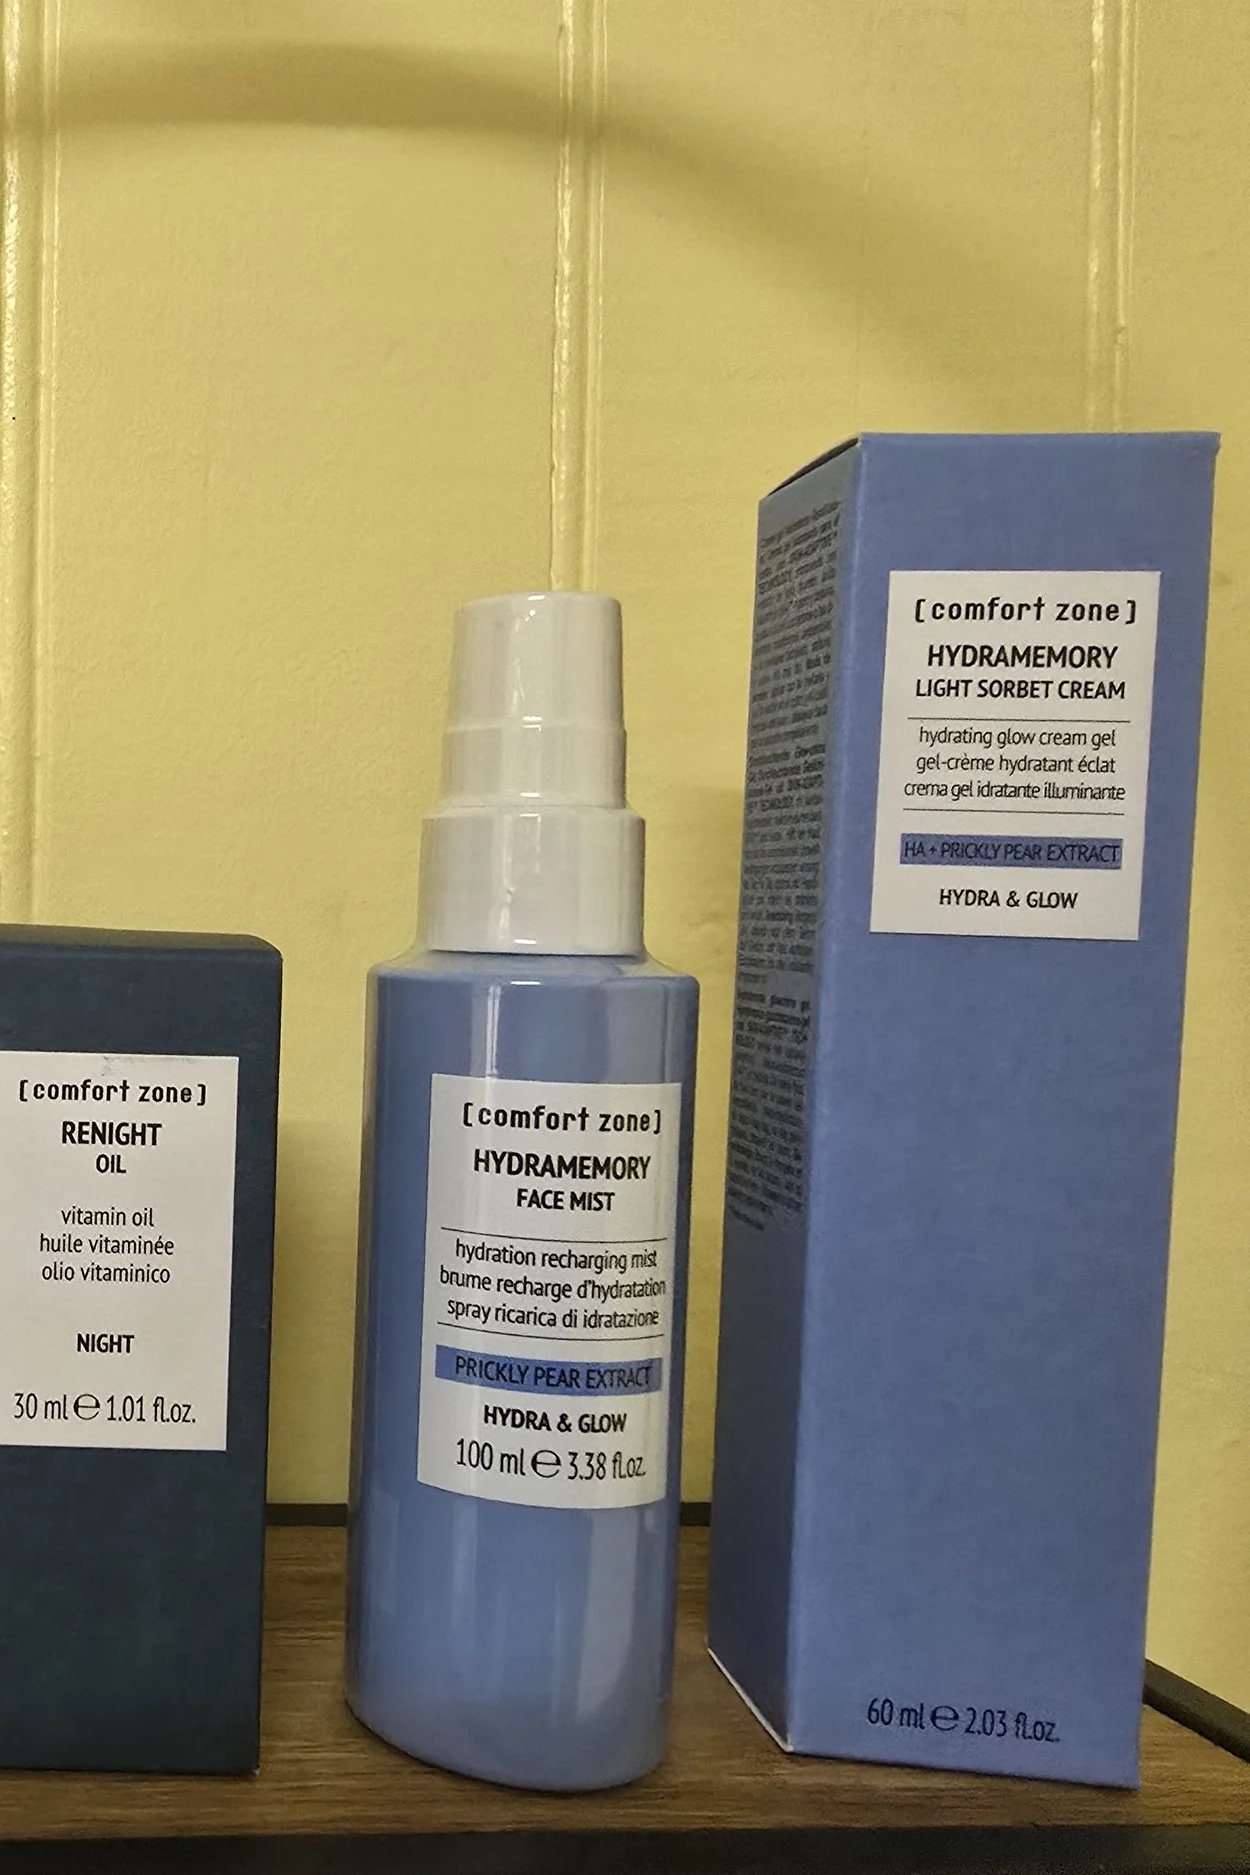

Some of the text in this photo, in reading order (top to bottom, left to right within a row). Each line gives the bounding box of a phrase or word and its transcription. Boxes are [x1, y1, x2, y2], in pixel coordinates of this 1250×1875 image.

[928, 645, 1118, 669] HYDRAMEMORY
[916, 679, 1125, 699] LIGHT SORBET CREAM
[919, 726, 1116, 751] hydrating glow cream gel
[916, 753, 1115, 776] gel-crème hydratant éclat
[904, 781, 1126, 801] crema gel idratante illuminante
[904, 841, 926, 857] HA
[941, 842, 1001, 860] PRICKLY
[1004, 843, 1042, 861] PEAR
[1047, 844, 1120, 863] EXTRACT
[939, 889, 1078, 909] HYDRA & GLOW
[62, 1121, 162, 1146] RENIGHT
[96, 1154, 126, 1173] OIL
[474, 1149, 651, 1180] HYDRAMEMORY
[517, 1188, 615, 1211] FACE MIST
[61, 1206, 154, 1227] vitamin oil
[40, 1233, 174, 1255] huile vitaminée
[456, 1238, 657, 1275] hydration recharging mist
[42, 1261, 170, 1283] olio vitaminico
[440, 1264, 491, 1291] brume
[497, 1276, 572, 1303] recharge
[447, 1300, 659, 1329] spray ricarica di idratazione
[77, 1333, 135, 1353] NIGHT
[455, 1355, 653, 1389] PRICKLY PEAR EXTRACT
[14, 1393, 38, 1419] 30
[44, 1394, 68, 1420] ml
[107, 1395, 146, 1422] 1.01
[153, 1396, 196, 1423] fl.oz.
[484, 1405, 627, 1433] HYDRA & GLOW
[457, 1438, 493, 1470] 100
[500, 1448, 526, 1476] ml
[568, 1451, 606, 1480] 3.38
[612, 1451, 646, 1479] fl.oz.
[867, 1698, 894, 1726] 60
[899, 1703, 925, 1730] ml
[965, 1707, 1007, 1737] 2.03
[1014, 1712, 1060, 1743] fl.oz.
